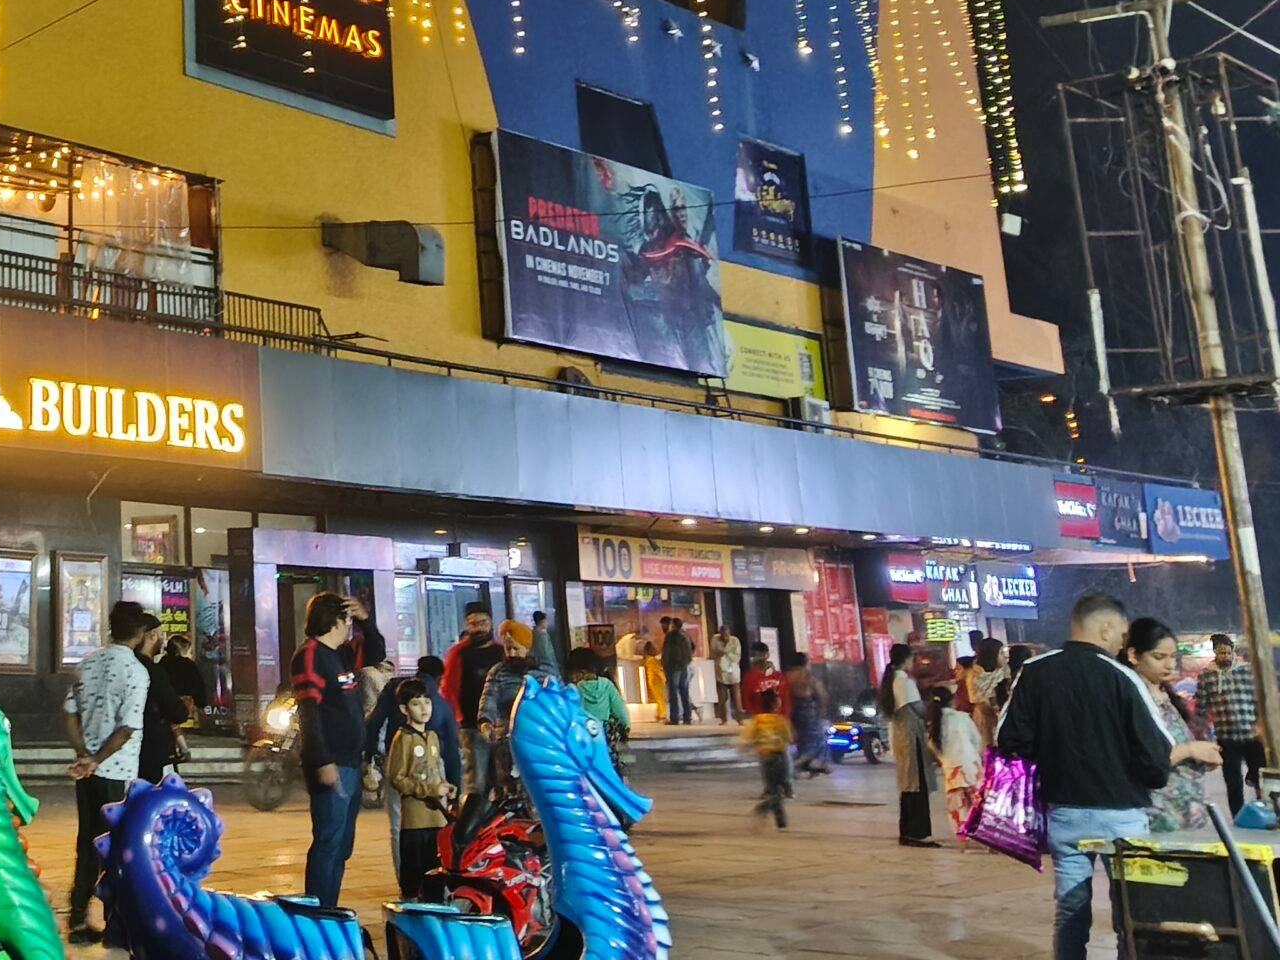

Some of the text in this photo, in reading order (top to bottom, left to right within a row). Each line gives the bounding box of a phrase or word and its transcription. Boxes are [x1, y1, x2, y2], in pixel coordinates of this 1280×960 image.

[528, 196, 600, 239] PREDATOR
[510, 219, 620, 263] BADLANDS
[28, 377, 245, 453] BUILDERS
[1176, 504, 1225, 529] LECKER
[1001, 577, 1038, 597] LECKER
